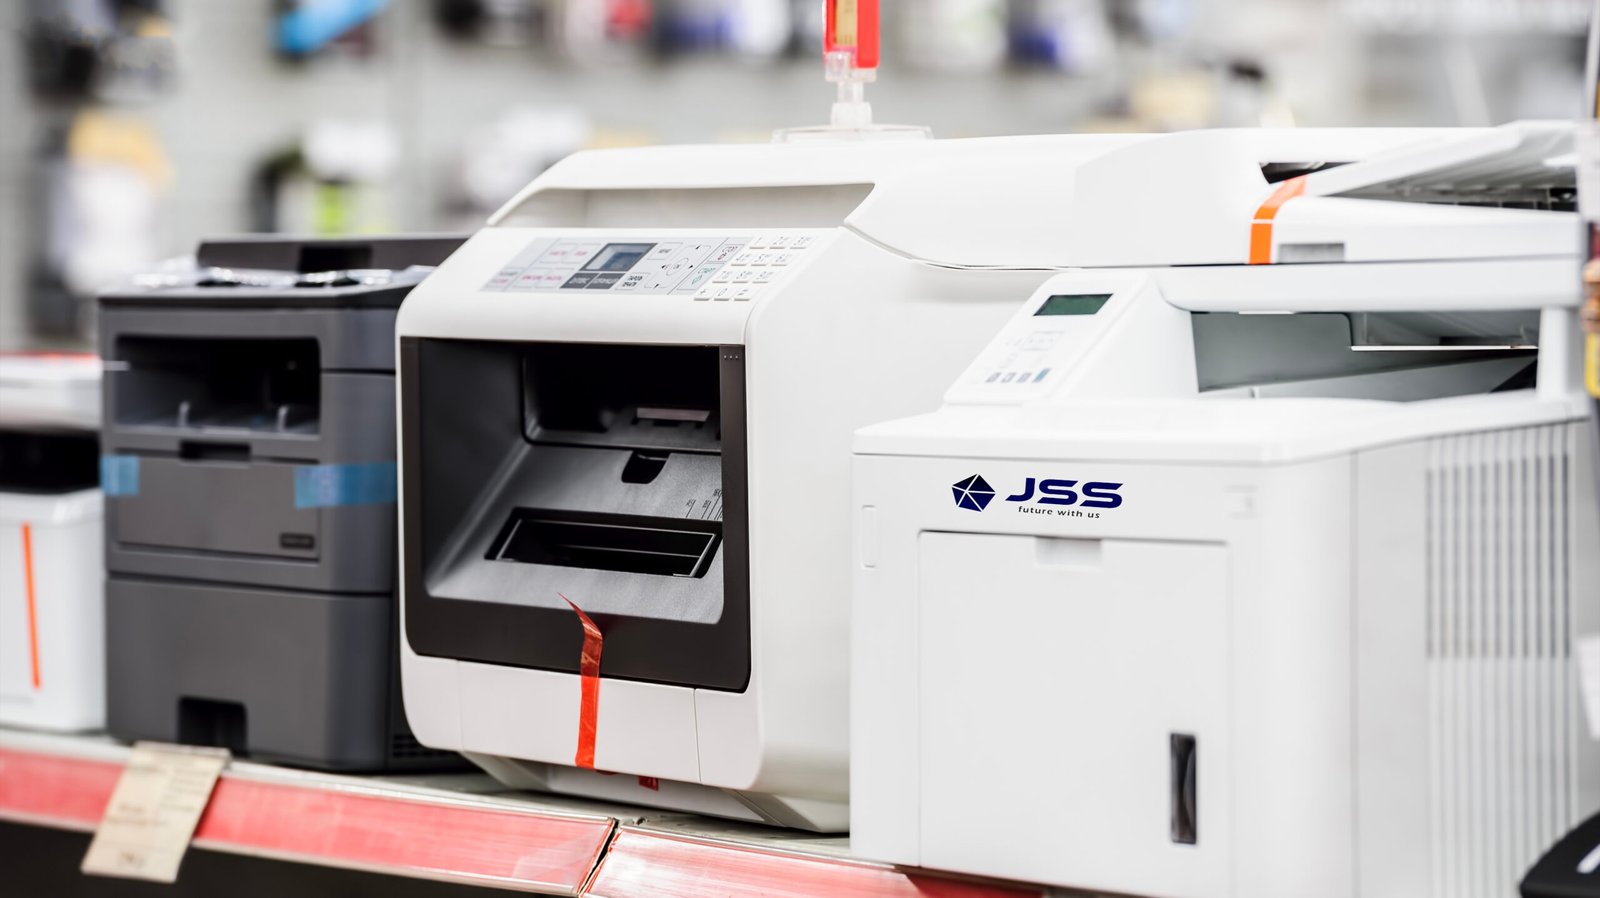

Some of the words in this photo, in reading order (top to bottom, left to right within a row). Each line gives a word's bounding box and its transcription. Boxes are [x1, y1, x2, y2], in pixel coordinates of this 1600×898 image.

[1005, 478, 1123, 508] JSS
[1018, 506, 1053, 516] future
[1057, 509, 1083, 518] with
